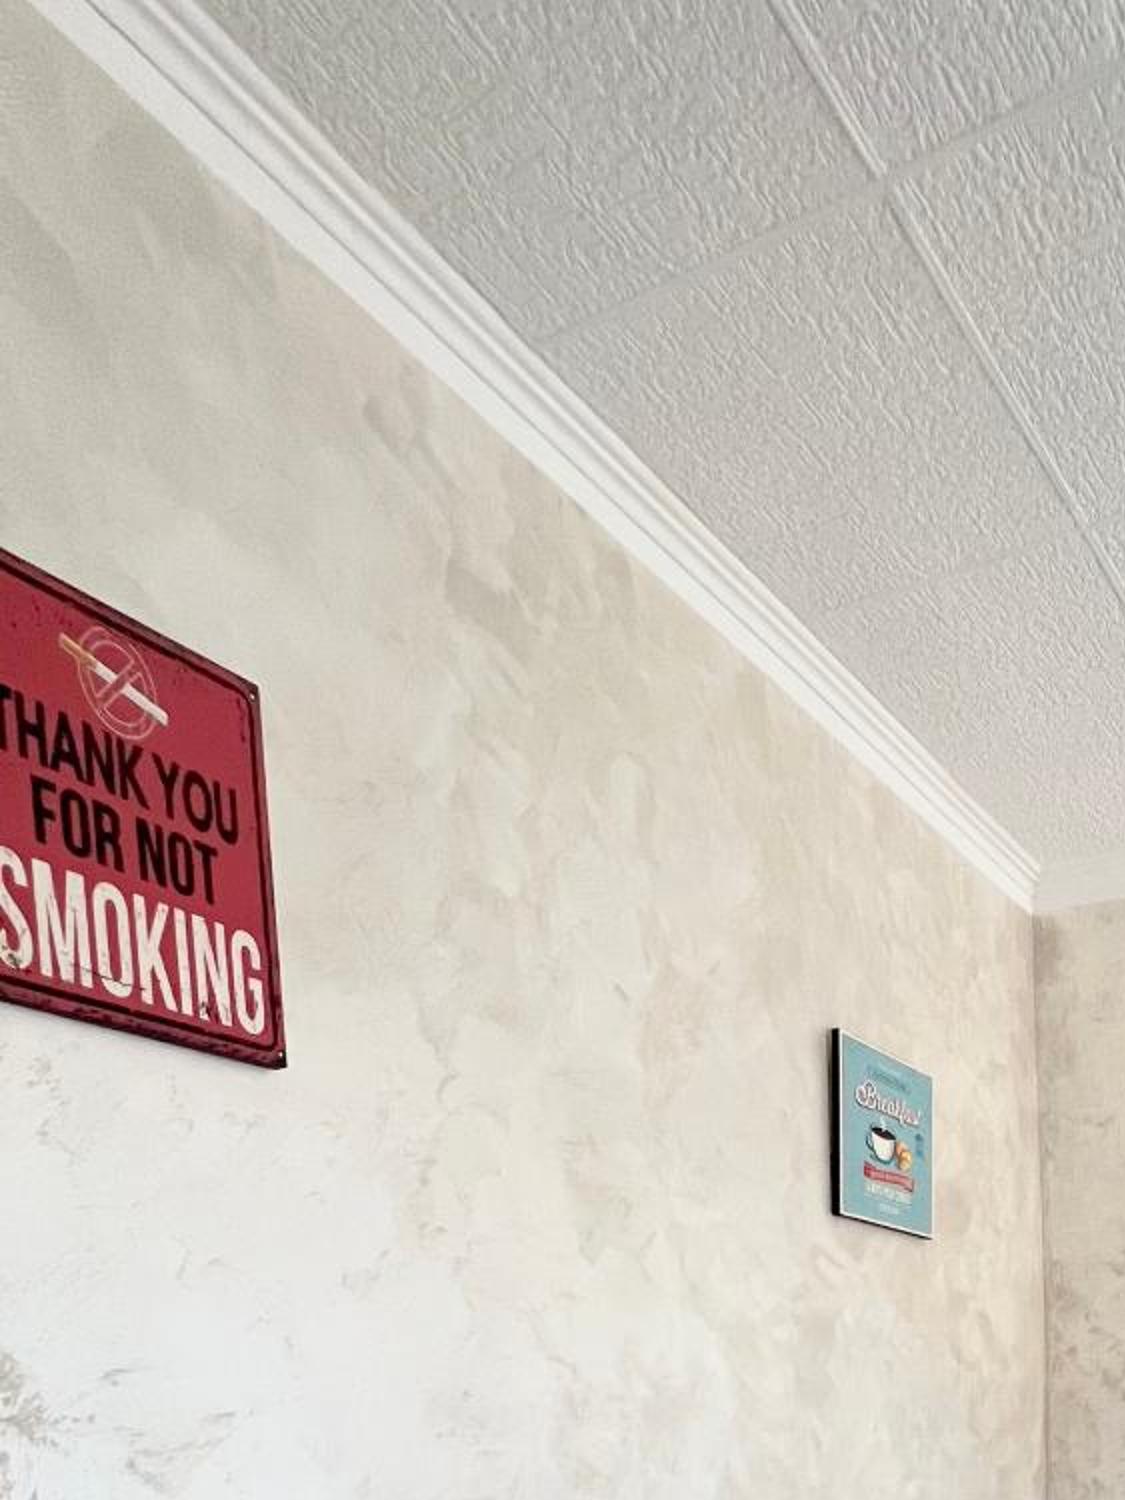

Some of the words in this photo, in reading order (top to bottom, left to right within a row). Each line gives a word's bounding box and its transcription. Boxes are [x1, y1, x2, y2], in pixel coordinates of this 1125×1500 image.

[0, 684, 150, 809] THANK
[152, 752, 239, 845] YOU
[30, 774, 124, 872] FOR
[135, 817, 218, 904] NOT
[0, 845, 265, 1035] SMOKING
